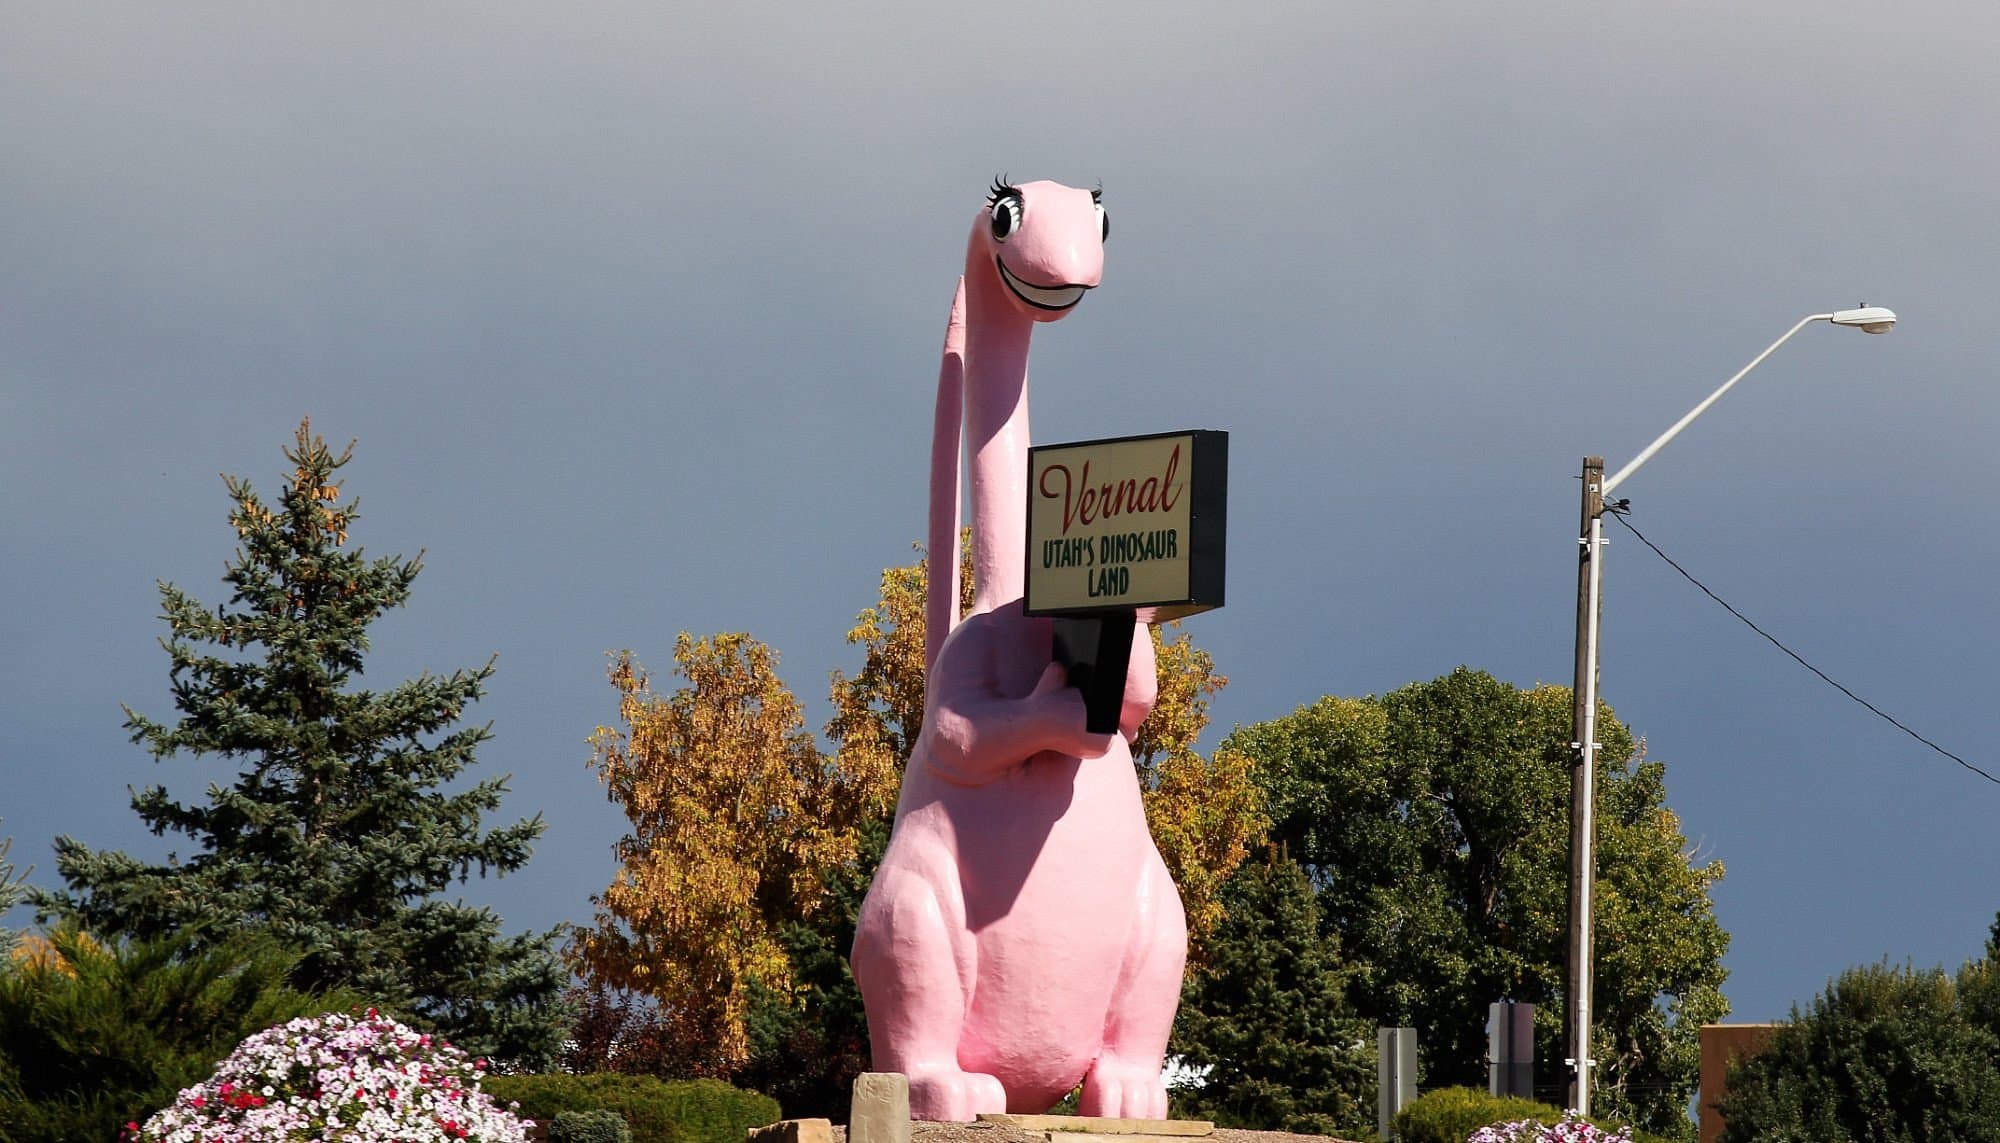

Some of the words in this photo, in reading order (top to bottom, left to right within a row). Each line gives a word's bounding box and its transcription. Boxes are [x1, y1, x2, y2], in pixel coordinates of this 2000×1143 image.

[1040, 443, 1183, 536] Vernal
[1043, 536, 1094, 568] UTAH'S
[1100, 529, 1177, 565] DINOSAUR
[1088, 566, 1129, 597] LAND
